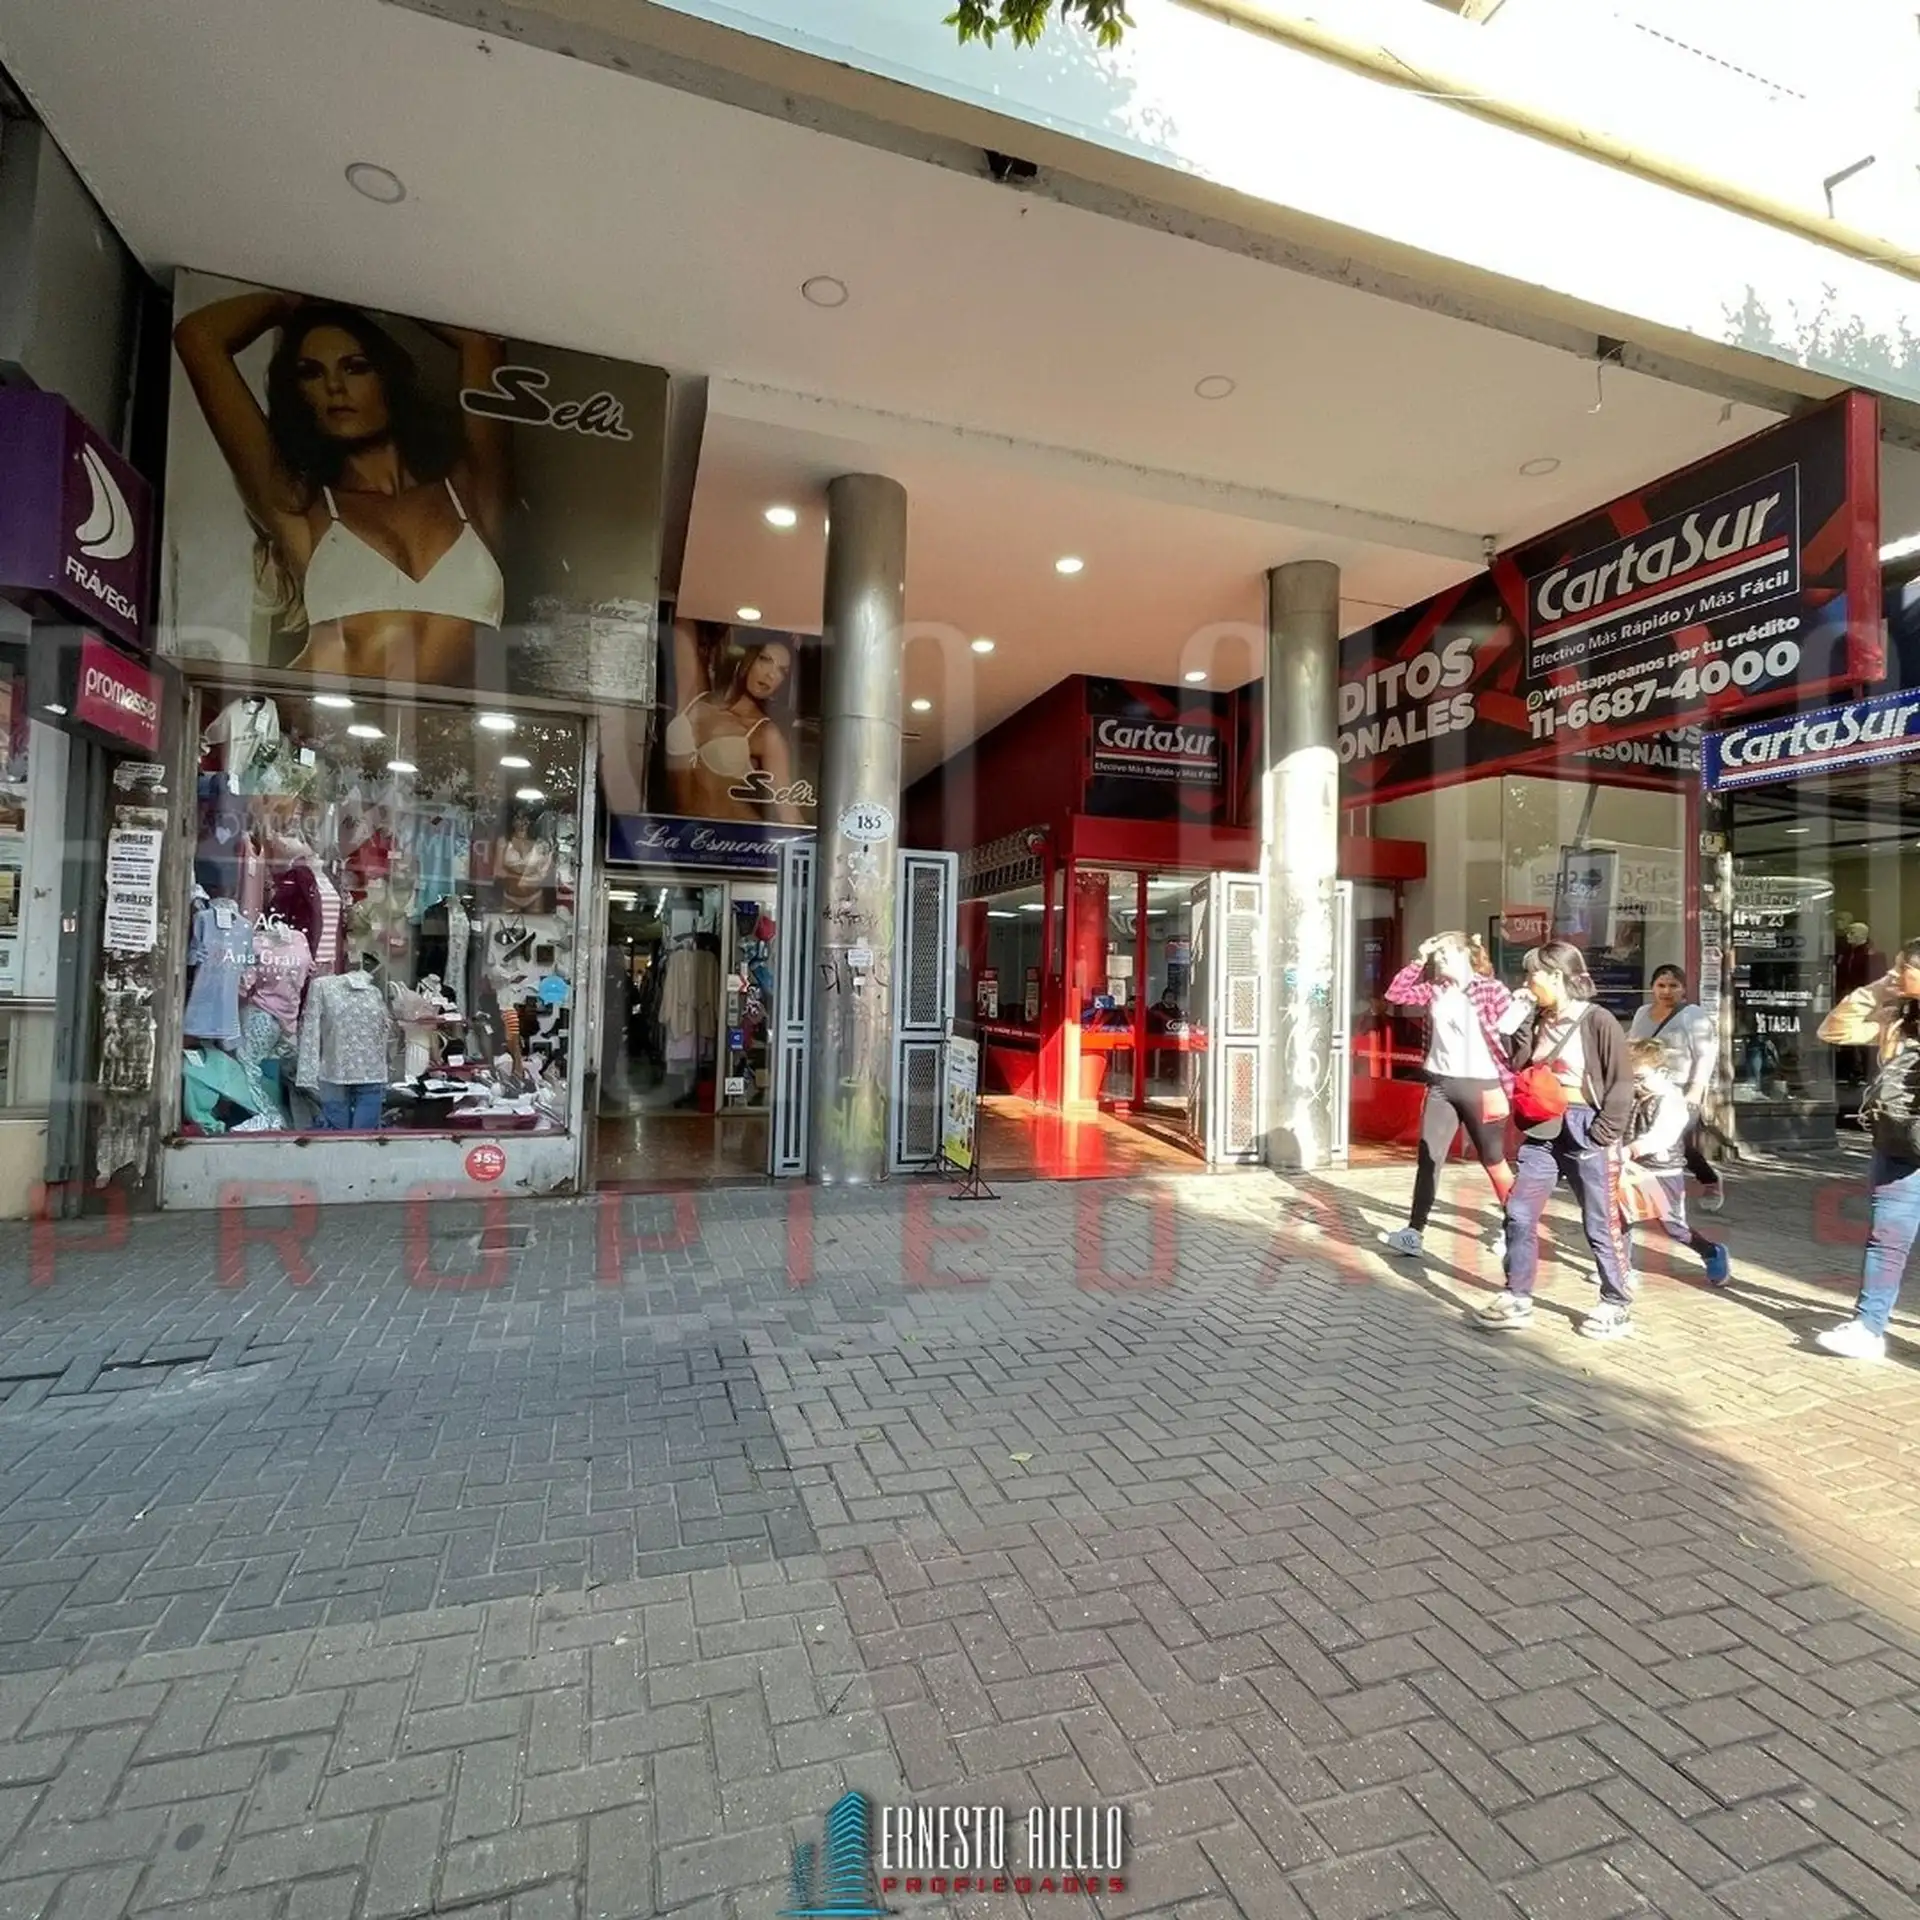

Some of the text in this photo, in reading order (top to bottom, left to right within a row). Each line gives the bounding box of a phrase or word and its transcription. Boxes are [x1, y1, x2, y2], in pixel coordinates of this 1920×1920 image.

[1537, 491, 1781, 621] CartaSur
[64, 555, 139, 625] FRÁVEGA
[1532, 569, 1790, 669] Efectivo Más Rápido y Más Fácil
[1529, 640, 1801, 740] 11-6687-4000
[1543, 615, 1801, 702] Whatsappeanos por tu crédito
[1098, 719, 1215, 755] CartaSur
[1719, 702, 1920, 768] CartaSur
[634, 823, 681, 849] La
[856, 814, 883, 831] 185
[222, 948, 256, 965] Ana
[1767, 1015, 1801, 1033] TABLA
